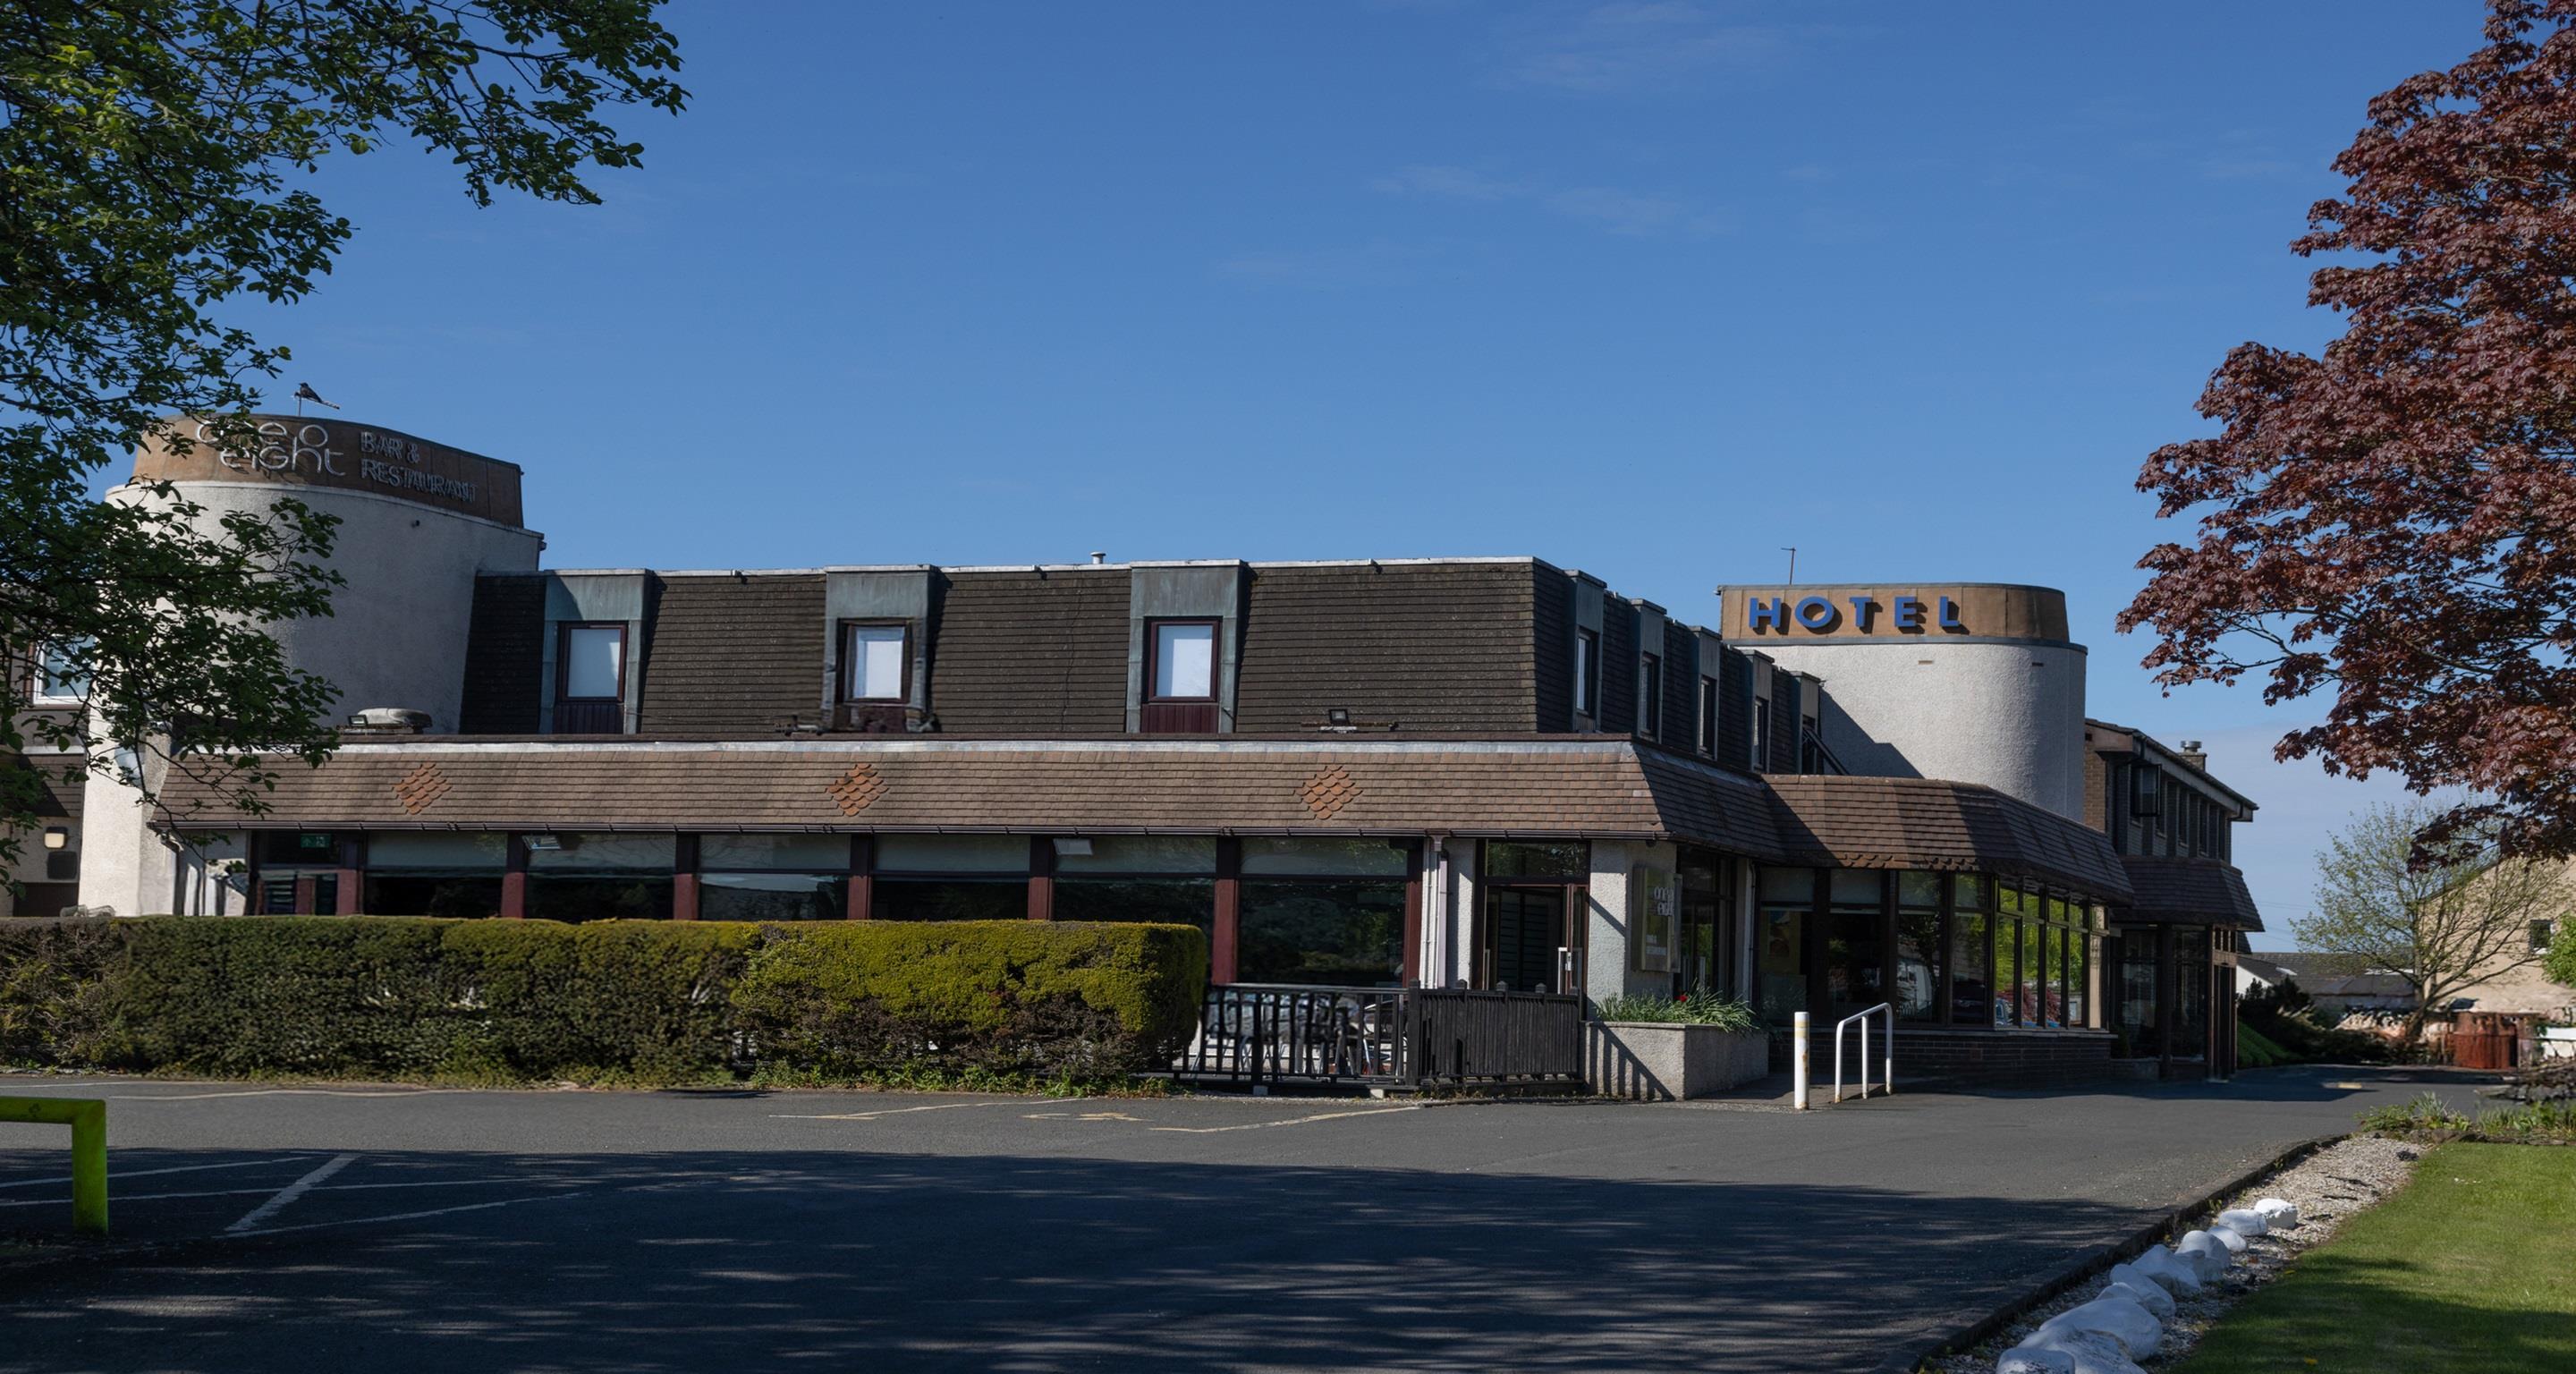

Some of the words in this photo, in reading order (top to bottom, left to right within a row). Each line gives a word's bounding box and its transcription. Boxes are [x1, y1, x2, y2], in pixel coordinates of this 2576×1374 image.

[360, 431, 402, 460] BAR
[407, 443, 420, 464] &
[360, 457, 477, 503] RESTAURANT
[1749, 595, 1961, 629] HOTEL
